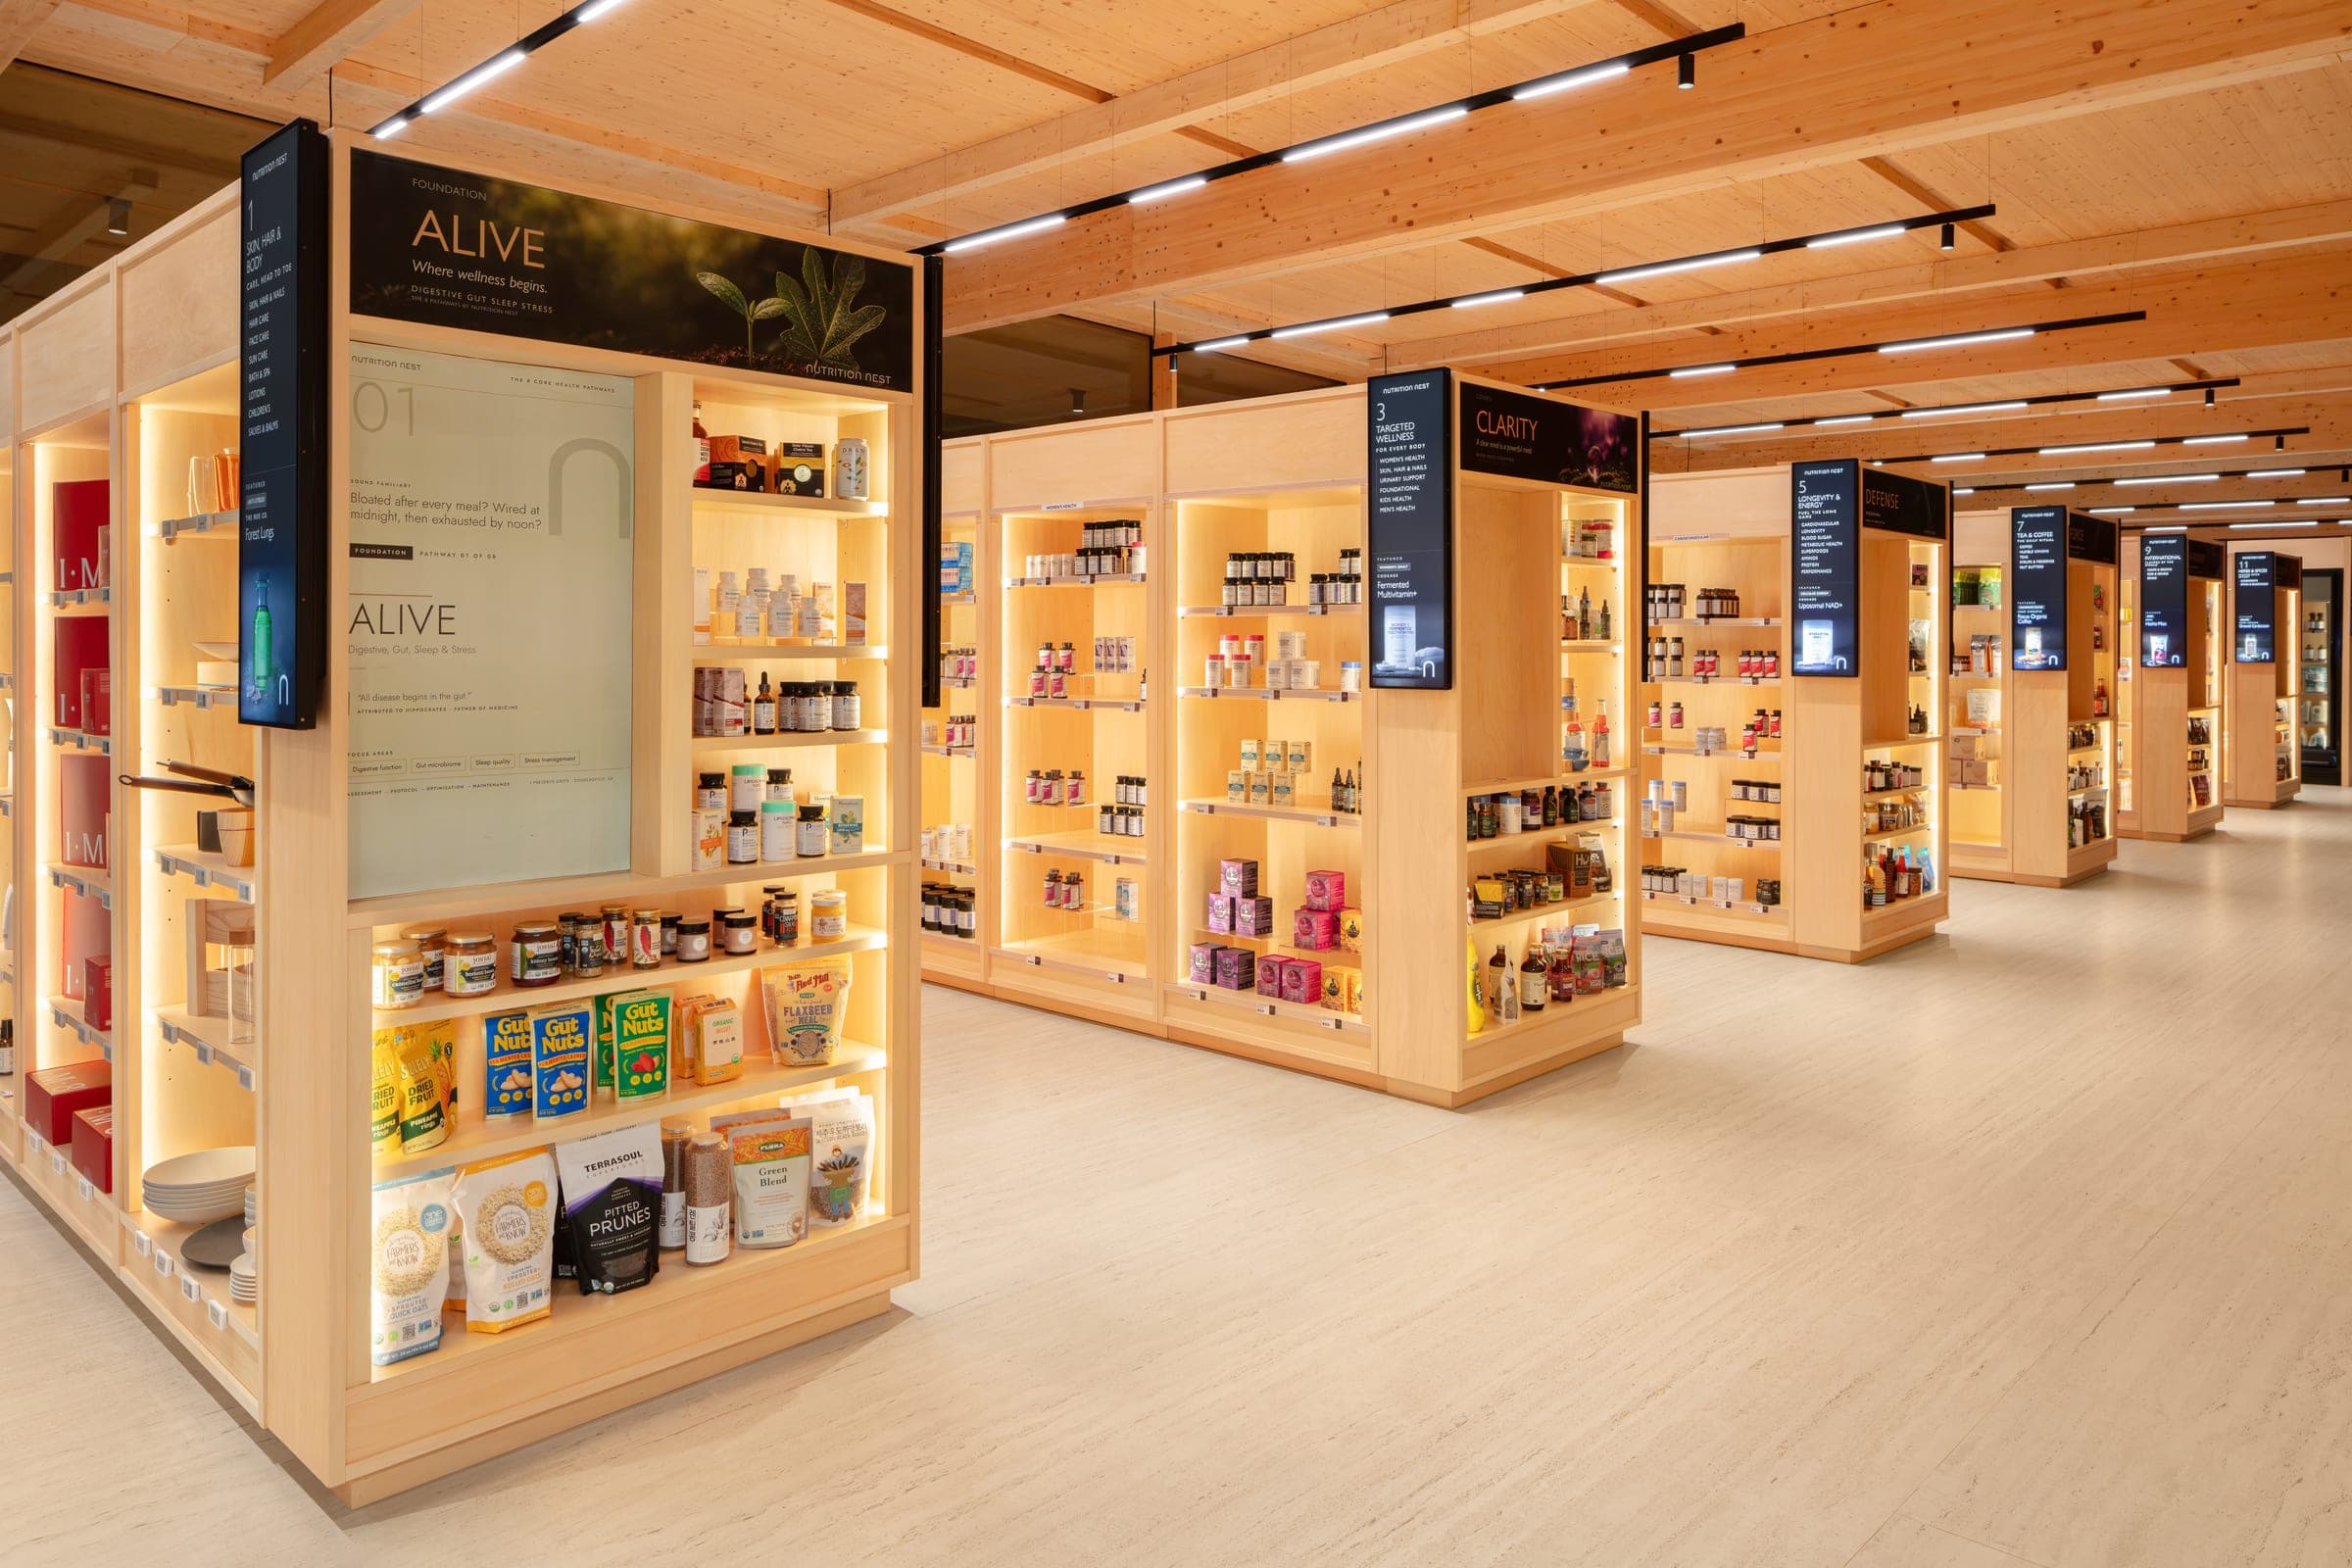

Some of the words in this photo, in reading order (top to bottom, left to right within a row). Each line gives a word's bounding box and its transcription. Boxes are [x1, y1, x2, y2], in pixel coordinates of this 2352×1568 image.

[412, 177, 487, 202] FOUNDATION
[261, 228, 276, 249] HAIR
[412, 210, 546, 270] ALIVE
[246, 253, 263, 274] BODY
[261, 271, 273, 284] HEAD
[274, 268, 281, 278] TO
[282, 262, 292, 274] TOE
[412, 259, 454, 280] Where
[458, 268, 506, 288] wellness
[510, 275, 549, 295] begins.
[411, 285, 463, 300] DIGESTIVE
[466, 293, 487, 304] GUT
[490, 297, 517, 308] SLEEP
[521, 302, 554, 314] STRESS
[583, 384, 615, 393] PATHWAYS
[353, 381, 415, 437] 01
[1377, 403, 1386, 420] 3
[1376, 422, 1415, 434] TARGETED
[1476, 410, 1539, 441] CLARITY
[1376, 432, 1414, 444] WELLNESS
[1798, 480, 1807, 494] 5
[350, 492, 391, 507] Bloated
[394, 494, 418, 509] after
[421, 500, 452, 512] every
[456, 501, 489, 512] meal?
[492, 502, 527, 514] Wired
[529, 506, 540, 515] at
[1797, 494, 1835, 503] LONGEVITY
[1866, 489, 1899, 510] DEFENSE
[350, 509, 401, 524] midnight,
[405, 513, 428, 523] then
[431, 514, 486, 527] exhausted
[490, 516, 504, 530] by
[507, 519, 542, 530] noon?
[2017, 520, 2025, 532] 7
[245, 527, 260, 541] Forest
[260, 526, 274, 542] Lungs
[355, 548, 407, 557] FOUNDATION
[2145, 546, 2152, 555] 9
[1377, 580, 1409, 589] Fermented
[1377, 590, 1418, 599] Multivitamin+
[348, 603, 456, 636] ALIVE
[348, 644, 390, 657] Digestive,
[392, 645, 412, 656] Gut,
[415, 645, 439, 657] Sleep
[441, 645, 449, 654] &
[451, 645, 476, 655] Stress
[372, 692, 401, 703] disease
[402, 692, 428, 704] begins
[429, 692, 438, 701] in
[439, 691, 452, 701] the
[352, 765, 378, 774] Digestive
[537, 942, 557, 952] jovial
[473, 955, 492, 964] jovial
[402, 964, 420, 973] jovial
[796, 976, 812, 993] Red
[625, 1002, 659, 1020] Gut
[784, 1004, 832, 1016] FLAXSEED
[497, 1017, 530, 1036] Gut
[545, 1017, 578, 1037] Gut
[622, 1017, 664, 1037] Nuts
[494, 1034, 530, 1053] Nut
[542, 1033, 584, 1054] Nuts
[408, 1079, 434, 1097] DRIED
[410, 1089, 434, 1105] FRUIT
[584, 1151, 643, 1173] TERRASOUL
[759, 1166, 788, 1177] Green
[760, 1176, 787, 1187] Blend
[605, 1200, 640, 1218] PITTED
[495, 1216, 526, 1233] FARMERS
[590, 1206, 651, 1237] PRUNES
[505, 1228, 526, 1241] KNOW
[387, 1242, 419, 1259] FARMERS
[396, 1255, 418, 1268] KNOW
[507, 1268, 538, 1282] SPROUTED
[391, 1298, 427, 1312] SPROUTED
[391, 1309, 413, 1319] QUICK
[413, 1304, 428, 1315] OATS
